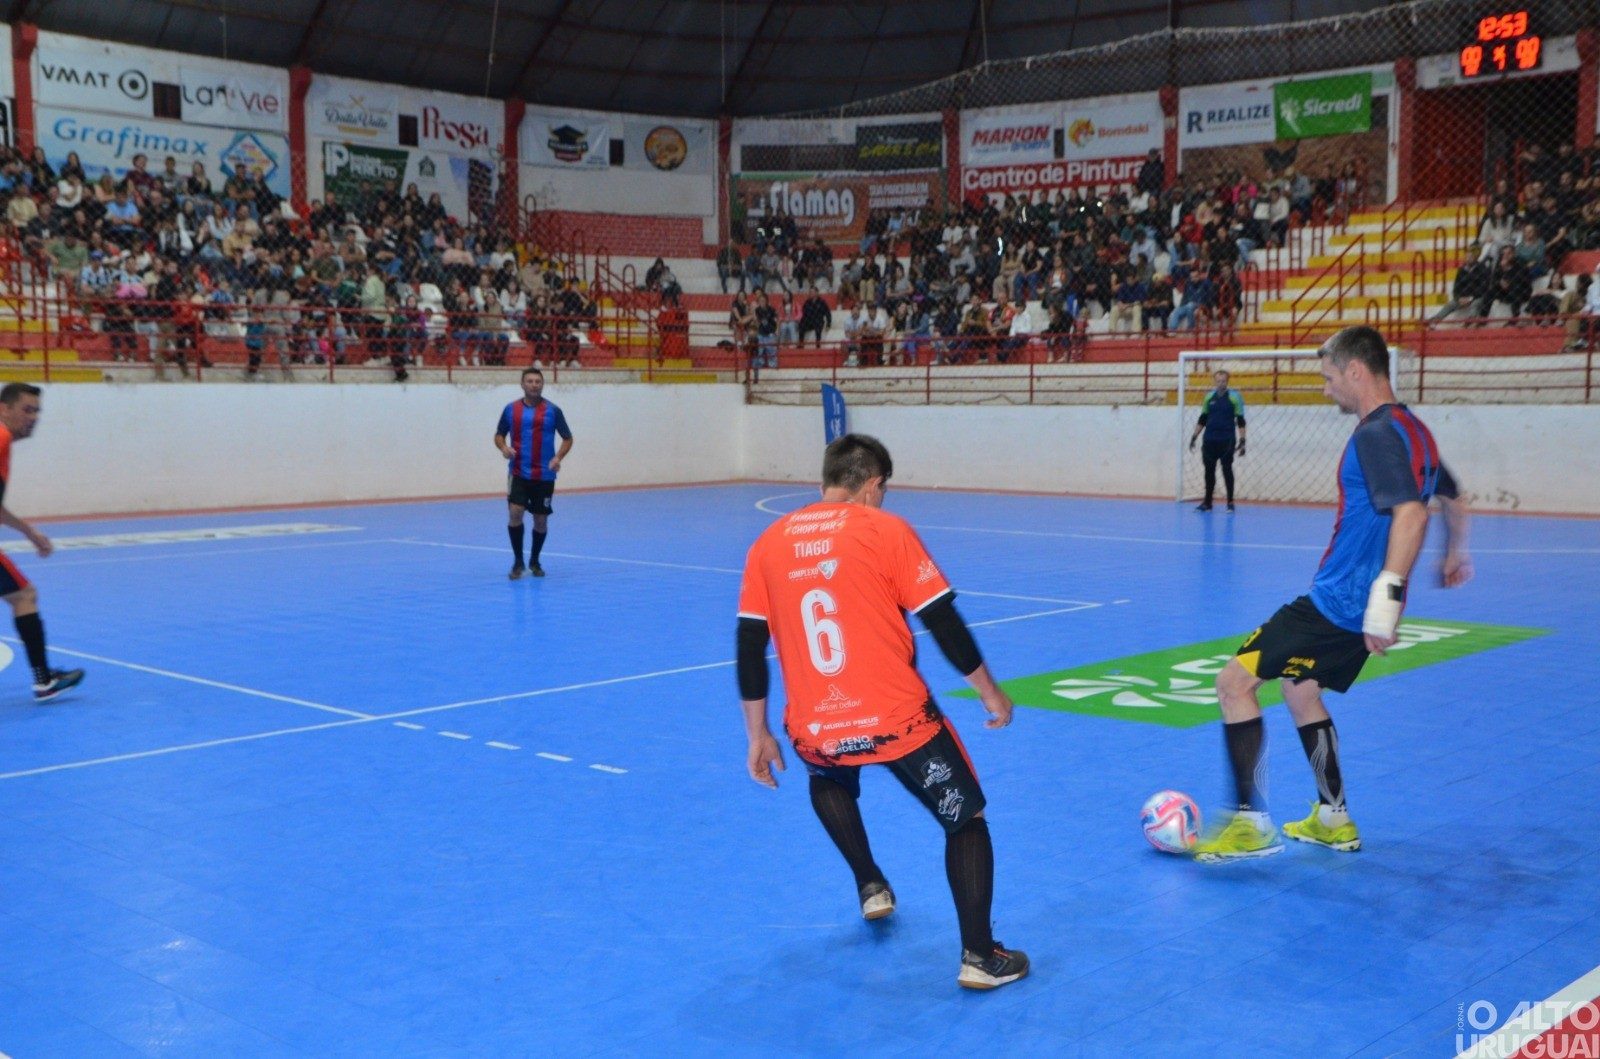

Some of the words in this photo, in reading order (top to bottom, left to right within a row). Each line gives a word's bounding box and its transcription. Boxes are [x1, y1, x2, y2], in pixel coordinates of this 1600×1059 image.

[41, 64, 109, 88] VMAT
[1206, 103, 1273, 124] REALIZE
[1302, 93, 1364, 117] Sicredi
[53, 116, 208, 159] Grafimax
[972, 125, 1051, 147] MARION
[964, 166, 1038, 190] Centro
[1039, 164, 1065, 186] de
[793, 539, 832, 558] TIAGO
[788, 567, 819, 580] COMPLEXO
[801, 589, 846, 677] 6
[823, 721, 851, 731] MURILO
[853, 716, 879, 726] PNEUS
[840, 735, 870, 746] FENO
